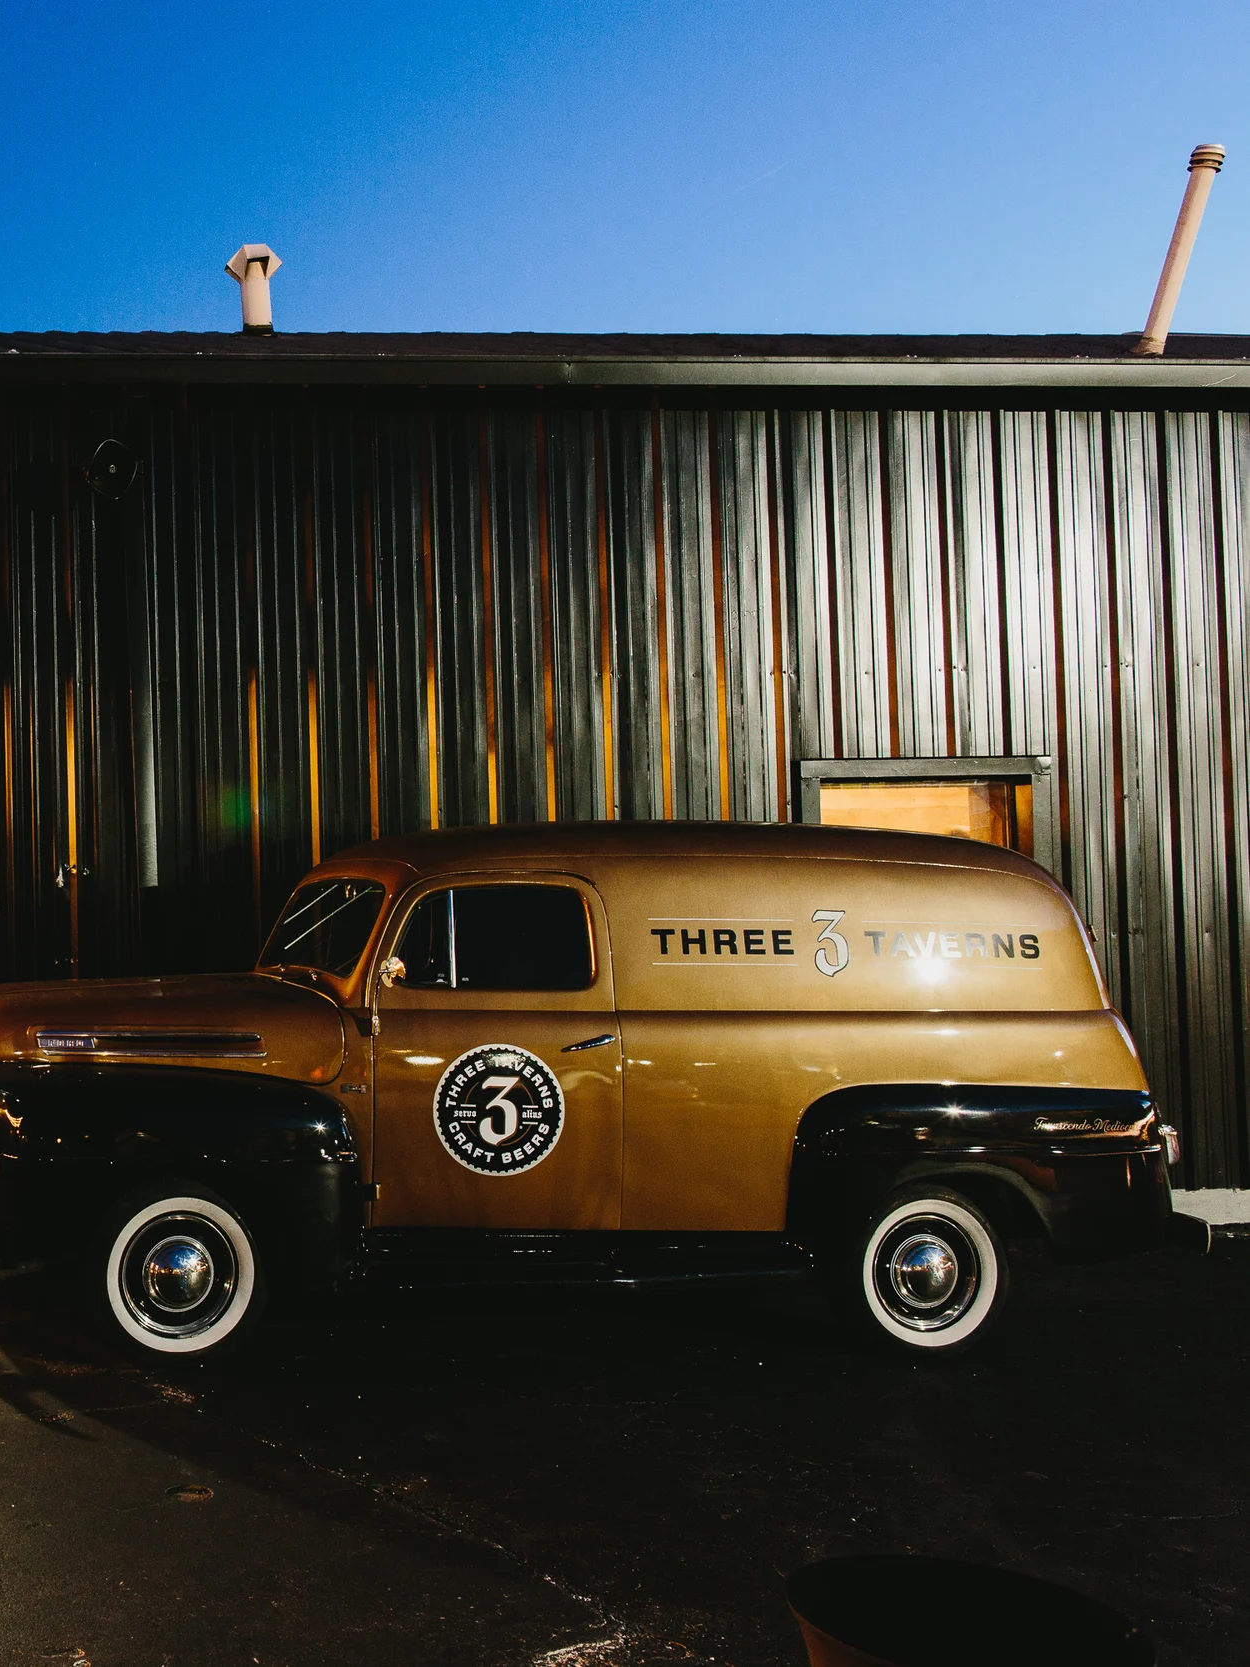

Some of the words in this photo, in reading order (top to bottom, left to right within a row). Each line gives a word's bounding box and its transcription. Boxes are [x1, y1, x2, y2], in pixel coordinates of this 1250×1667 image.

[650, 928, 795, 955] THREE
[810, 909, 850, 977] 3
[863, 930, 1041, 959] TAVERNS
[445, 1059, 486, 1108] THREE
[453, 1109, 477, 1118] servo
[521, 1109, 543, 1119] alius
[479, 1075, 520, 1147] 3
[1033, 1116, 1092, 1131] Trscendo
[448, 1121, 495, 1163] CRAFT
[501, 1123, 550, 1164] BEERS
